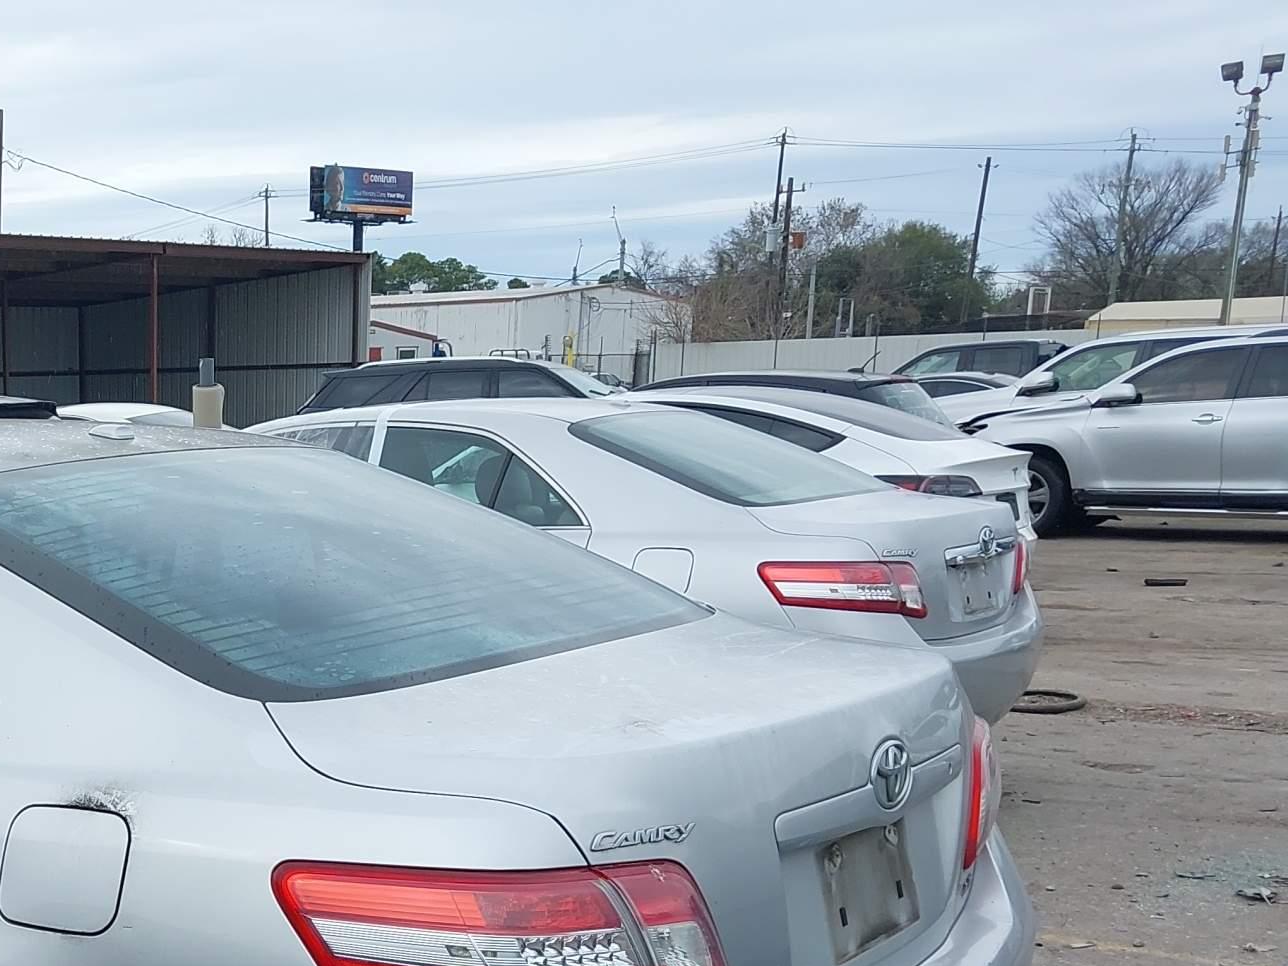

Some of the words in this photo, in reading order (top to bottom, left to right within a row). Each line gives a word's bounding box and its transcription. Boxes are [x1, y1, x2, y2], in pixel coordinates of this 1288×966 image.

[369, 172, 397, 184] centrum
[881, 548, 919, 558] CAMRY
[590, 822, 697, 852] CAMRY
